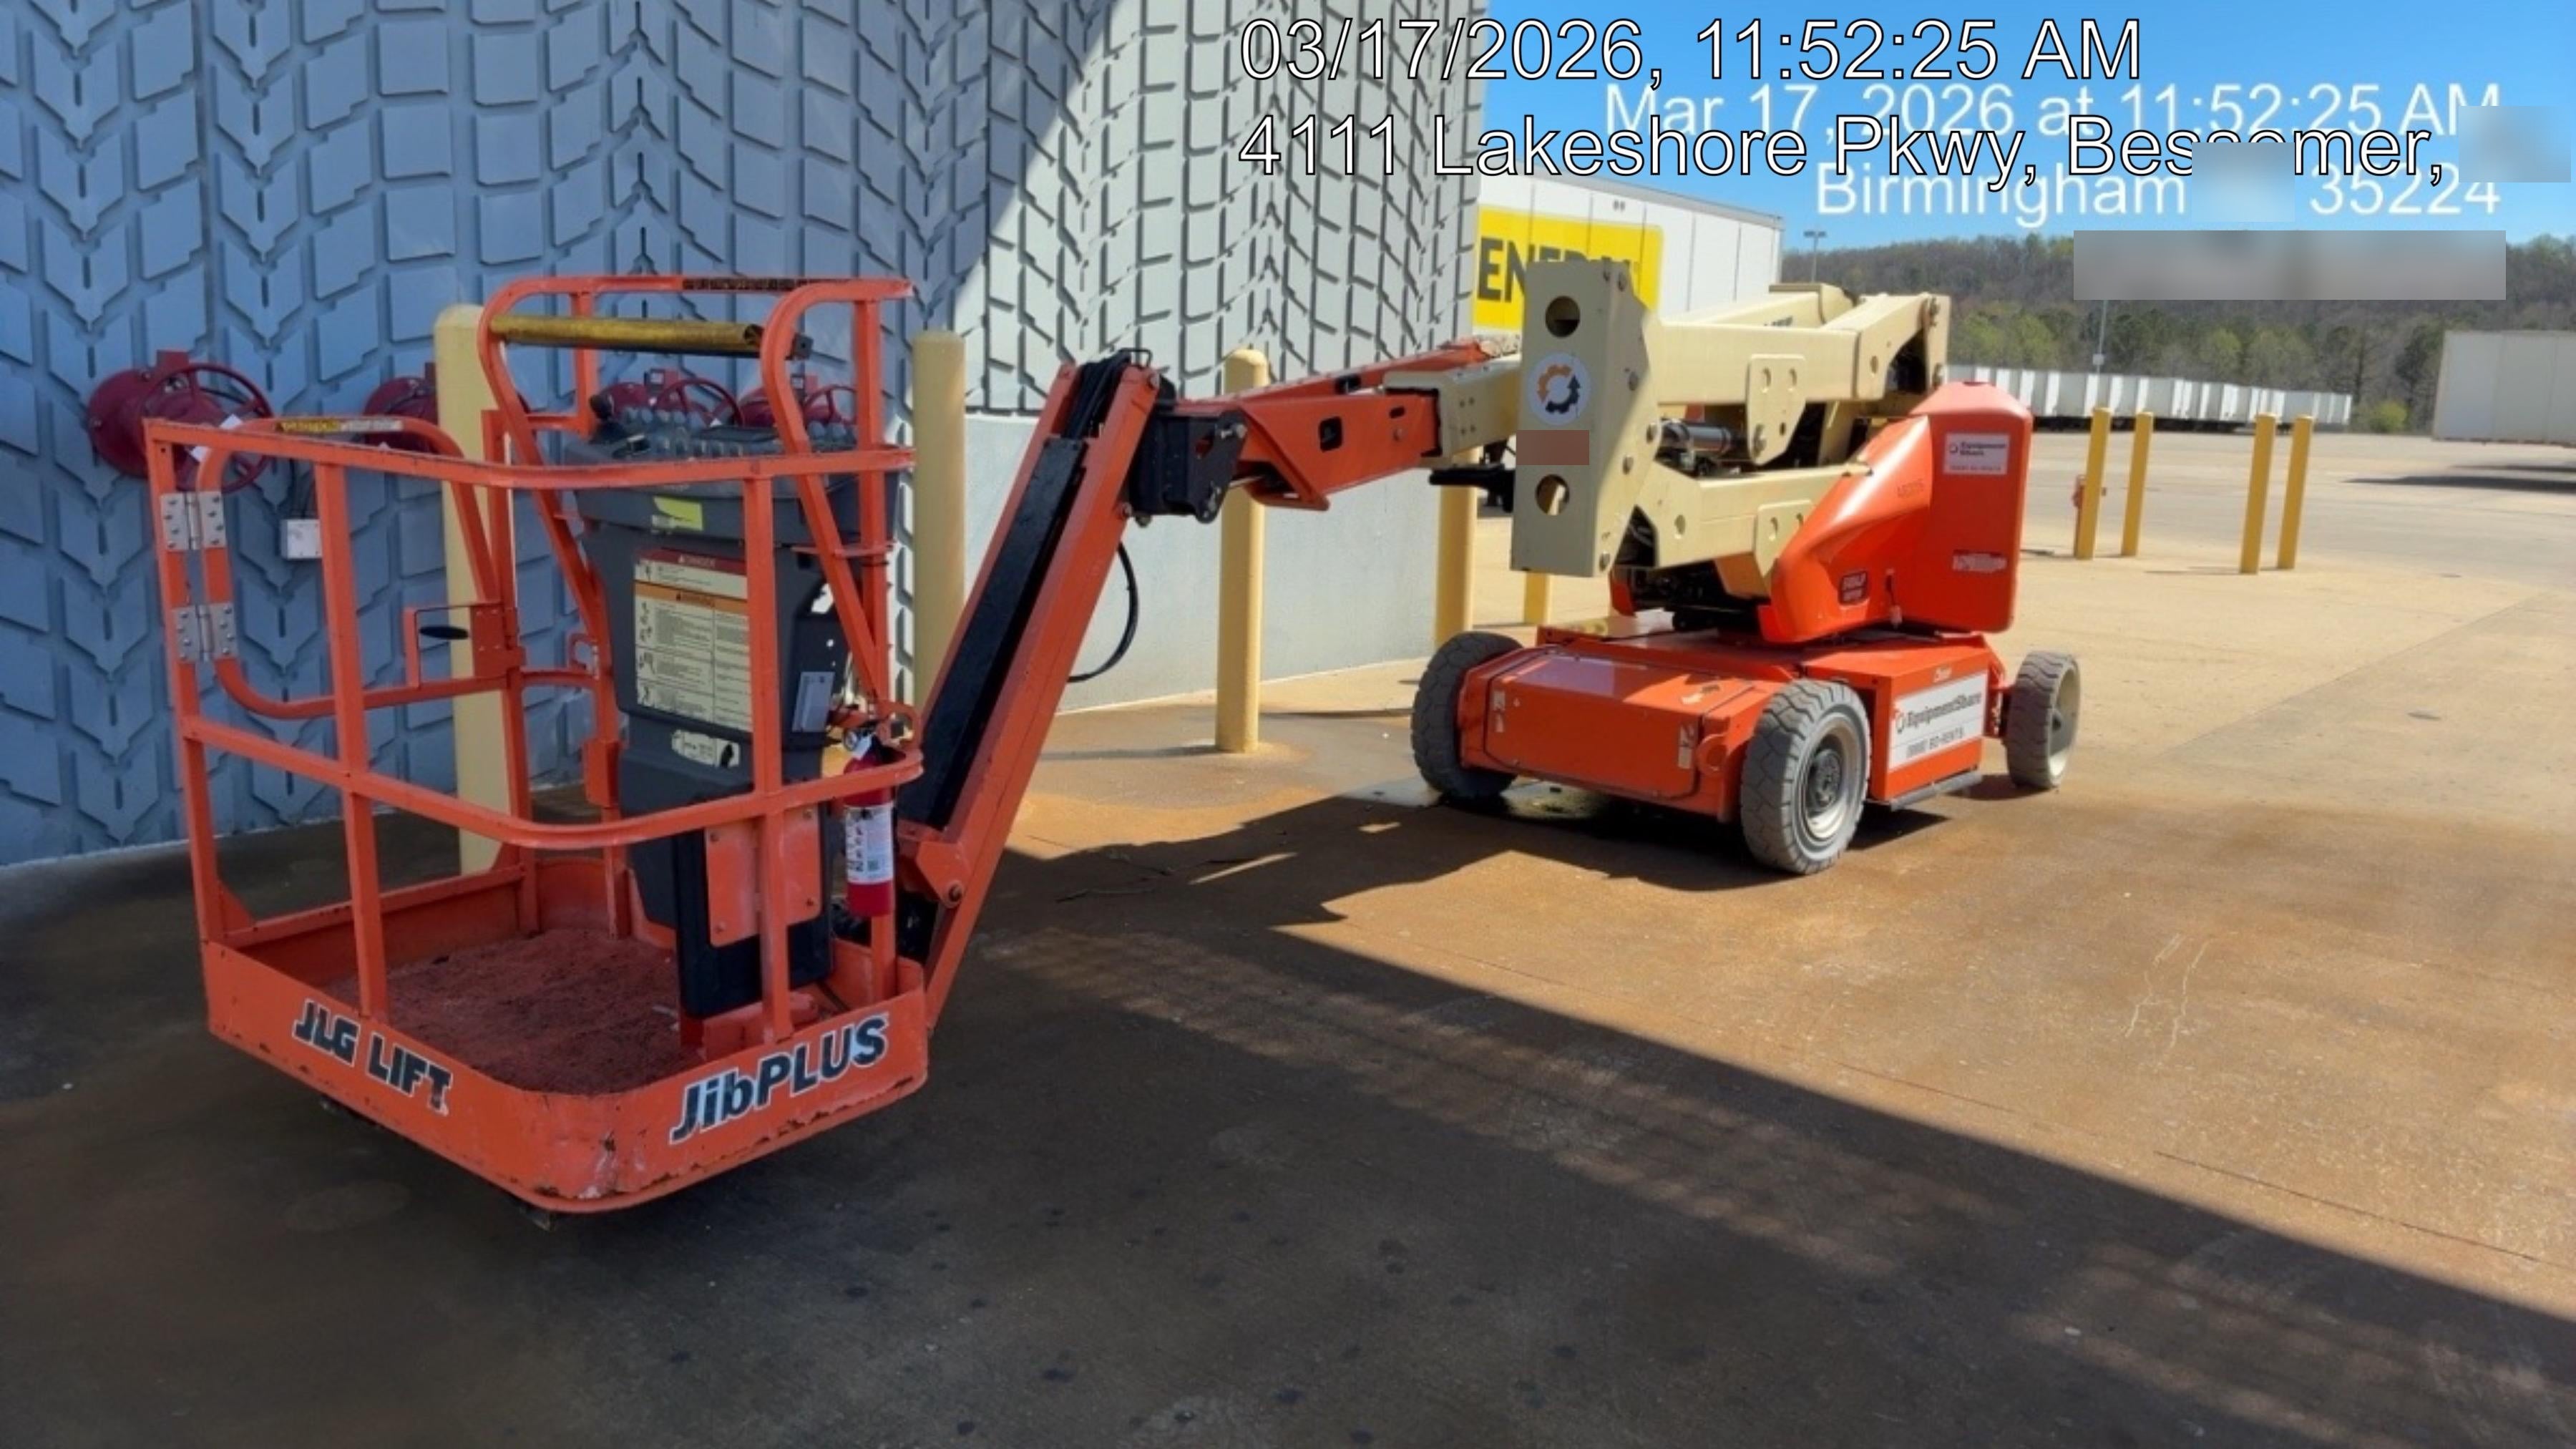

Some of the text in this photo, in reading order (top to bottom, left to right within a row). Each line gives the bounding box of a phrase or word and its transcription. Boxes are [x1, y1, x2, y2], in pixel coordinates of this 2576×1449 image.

[292, 999, 454, 1116] JLG LIFT
[669, 1011, 890, 1146] JibPLUS
